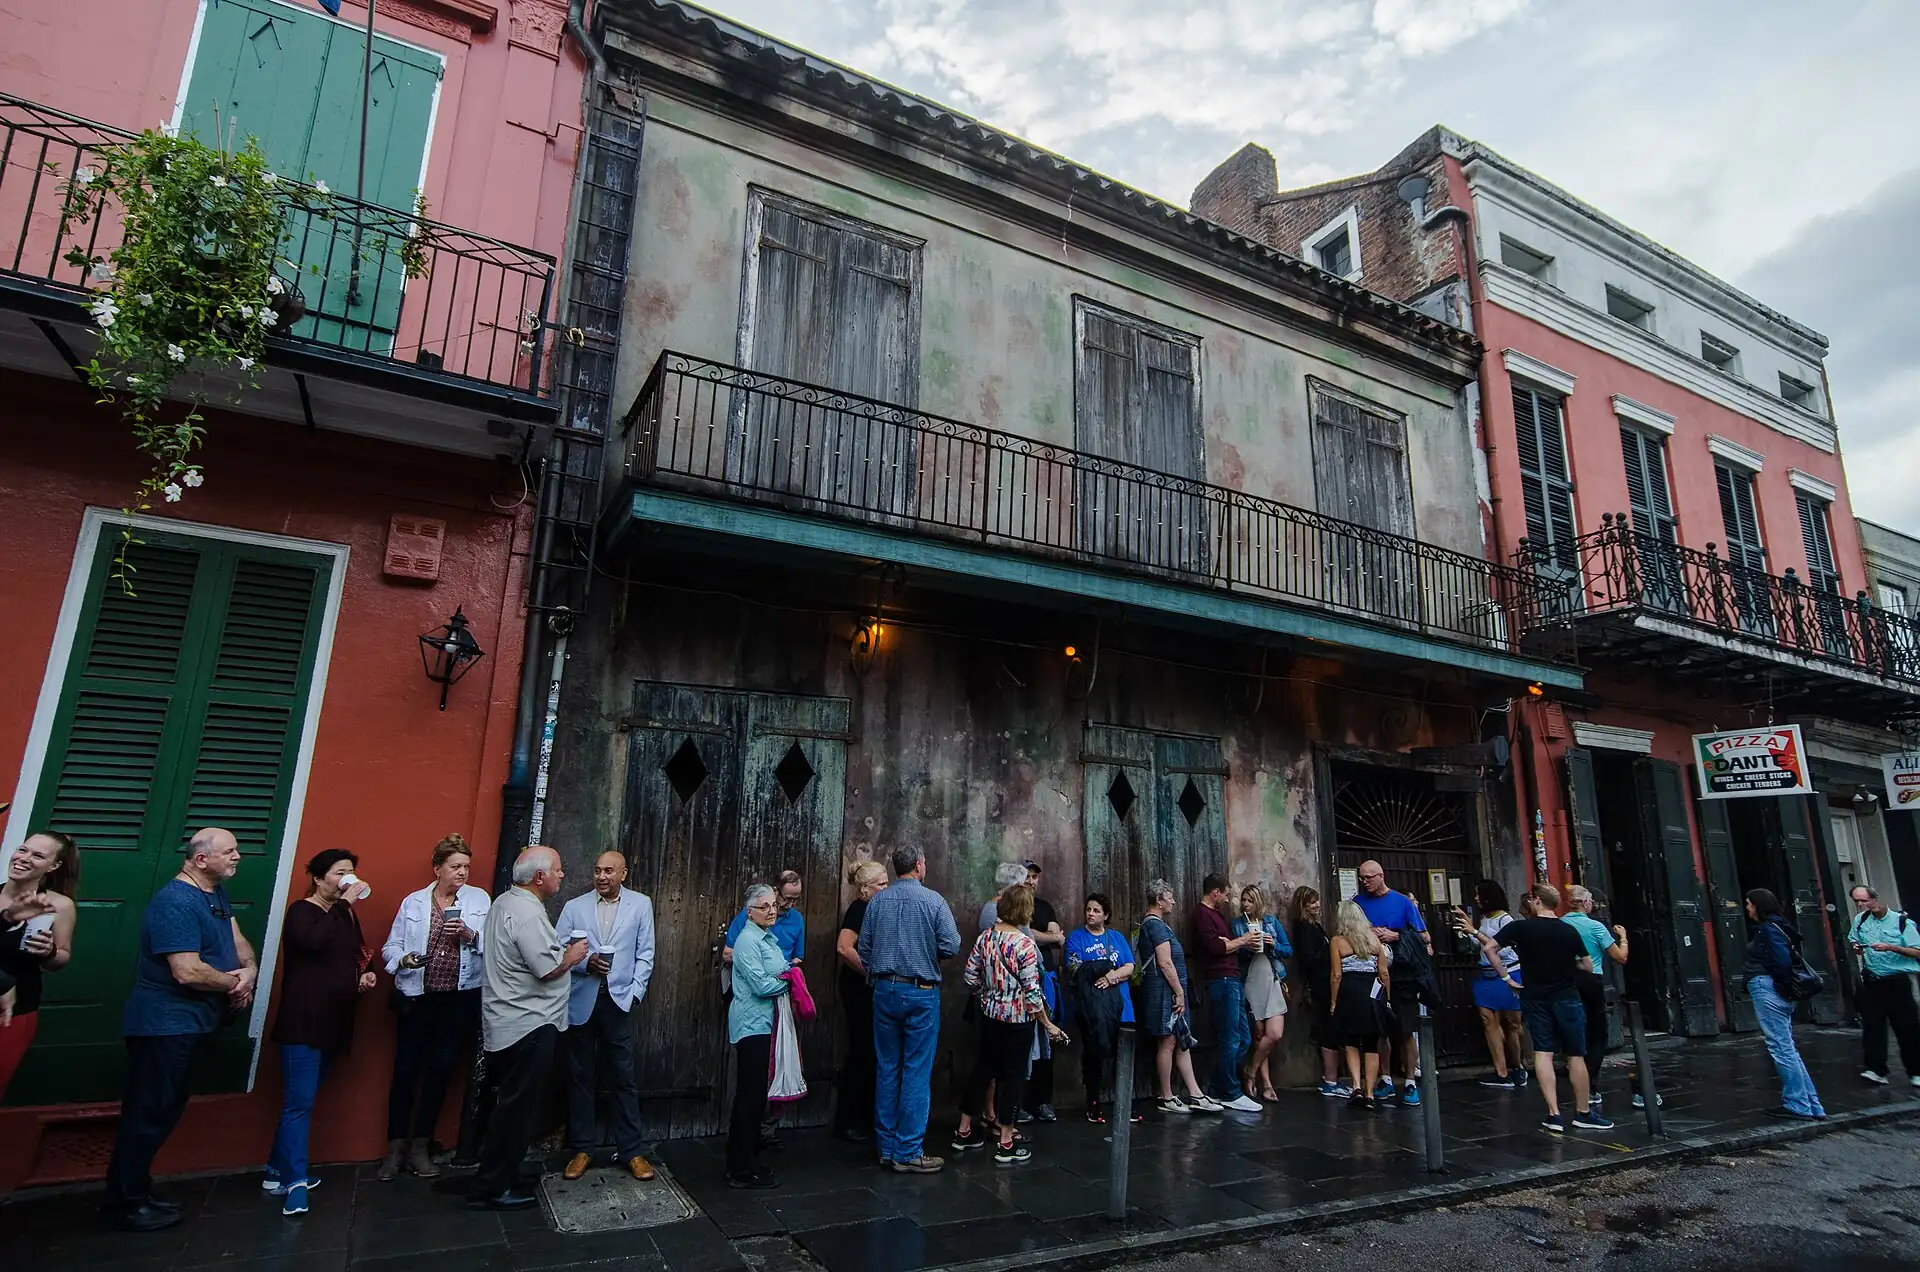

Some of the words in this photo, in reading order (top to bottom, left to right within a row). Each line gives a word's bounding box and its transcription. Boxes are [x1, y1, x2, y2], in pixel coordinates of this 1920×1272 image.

[1712, 736, 1779, 753] PIZZA
[1714, 754, 1787, 771] DANTE
[1713, 775, 1734, 783] WINGS
[1744, 773, 1767, 781] CHEESE
[1769, 771, 1792, 779] STICKS
[1726, 782, 1752, 790] CHICKEN
[1755, 780, 1782, 788] TENDERS
